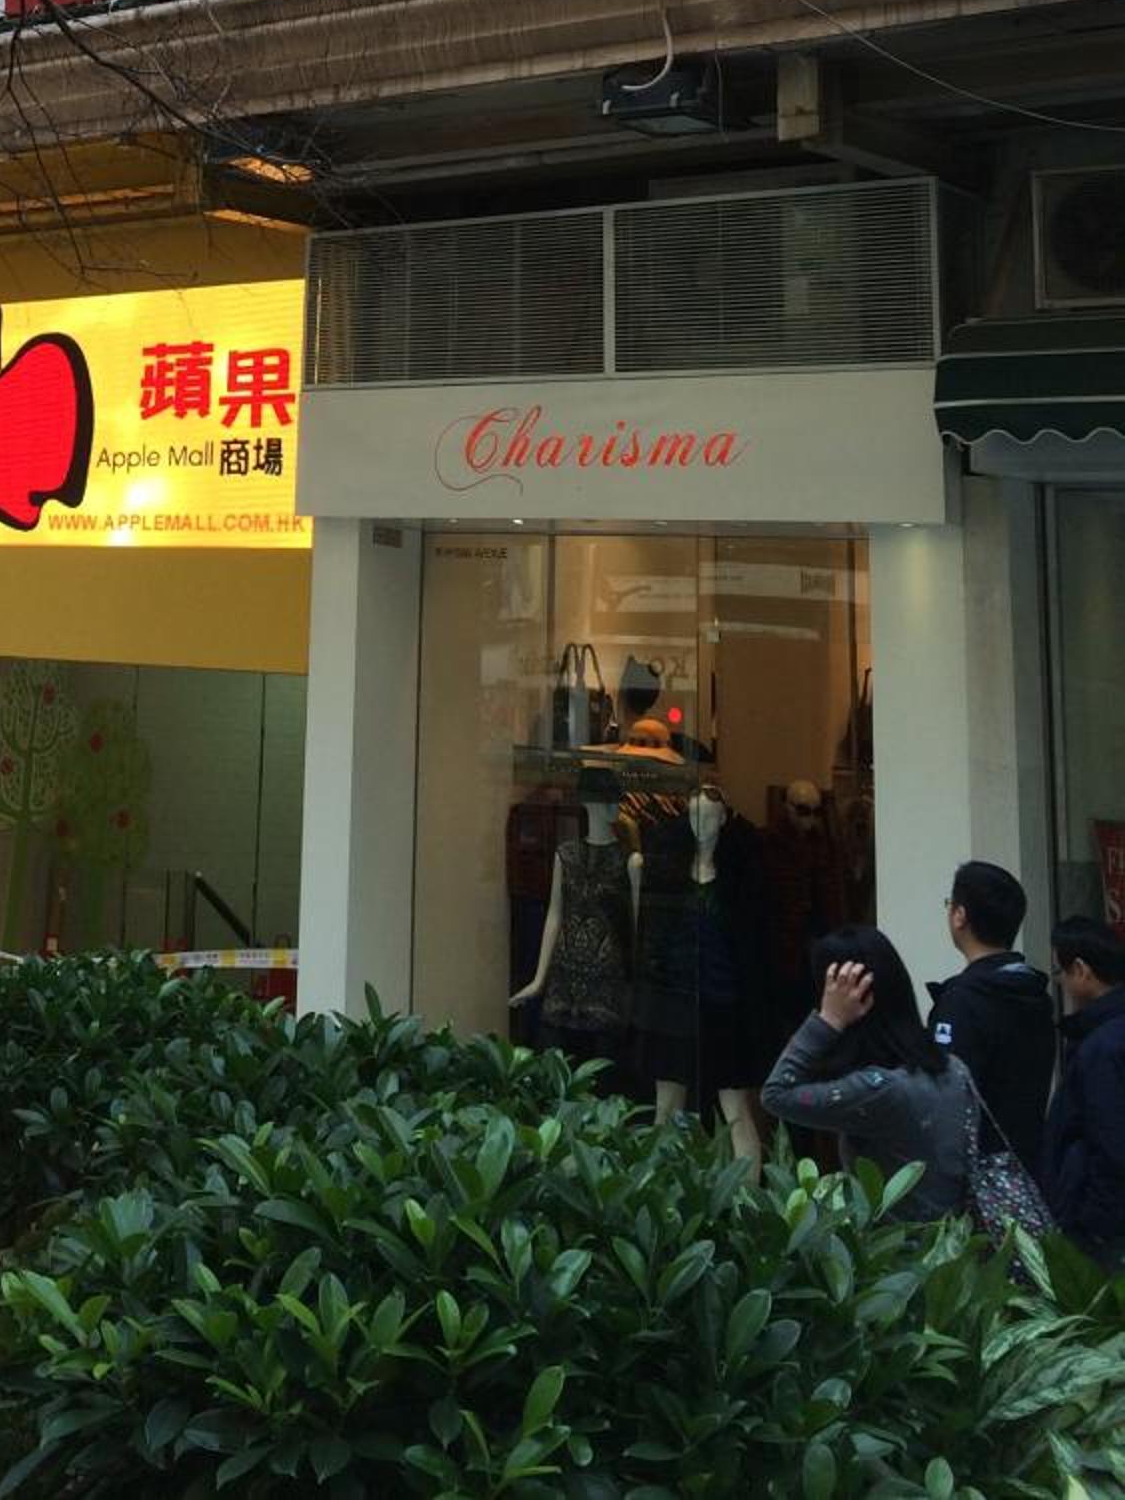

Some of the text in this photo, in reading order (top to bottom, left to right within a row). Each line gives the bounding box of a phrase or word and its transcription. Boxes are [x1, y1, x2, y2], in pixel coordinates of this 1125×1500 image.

[139, 340, 296, 428] 蘋果
[95, 437, 283, 477] Apple Mall 商場
[435, 404, 751, 497] Charisma
[47, 513, 306, 533] WWW.APPLEMALL.COM.HK
